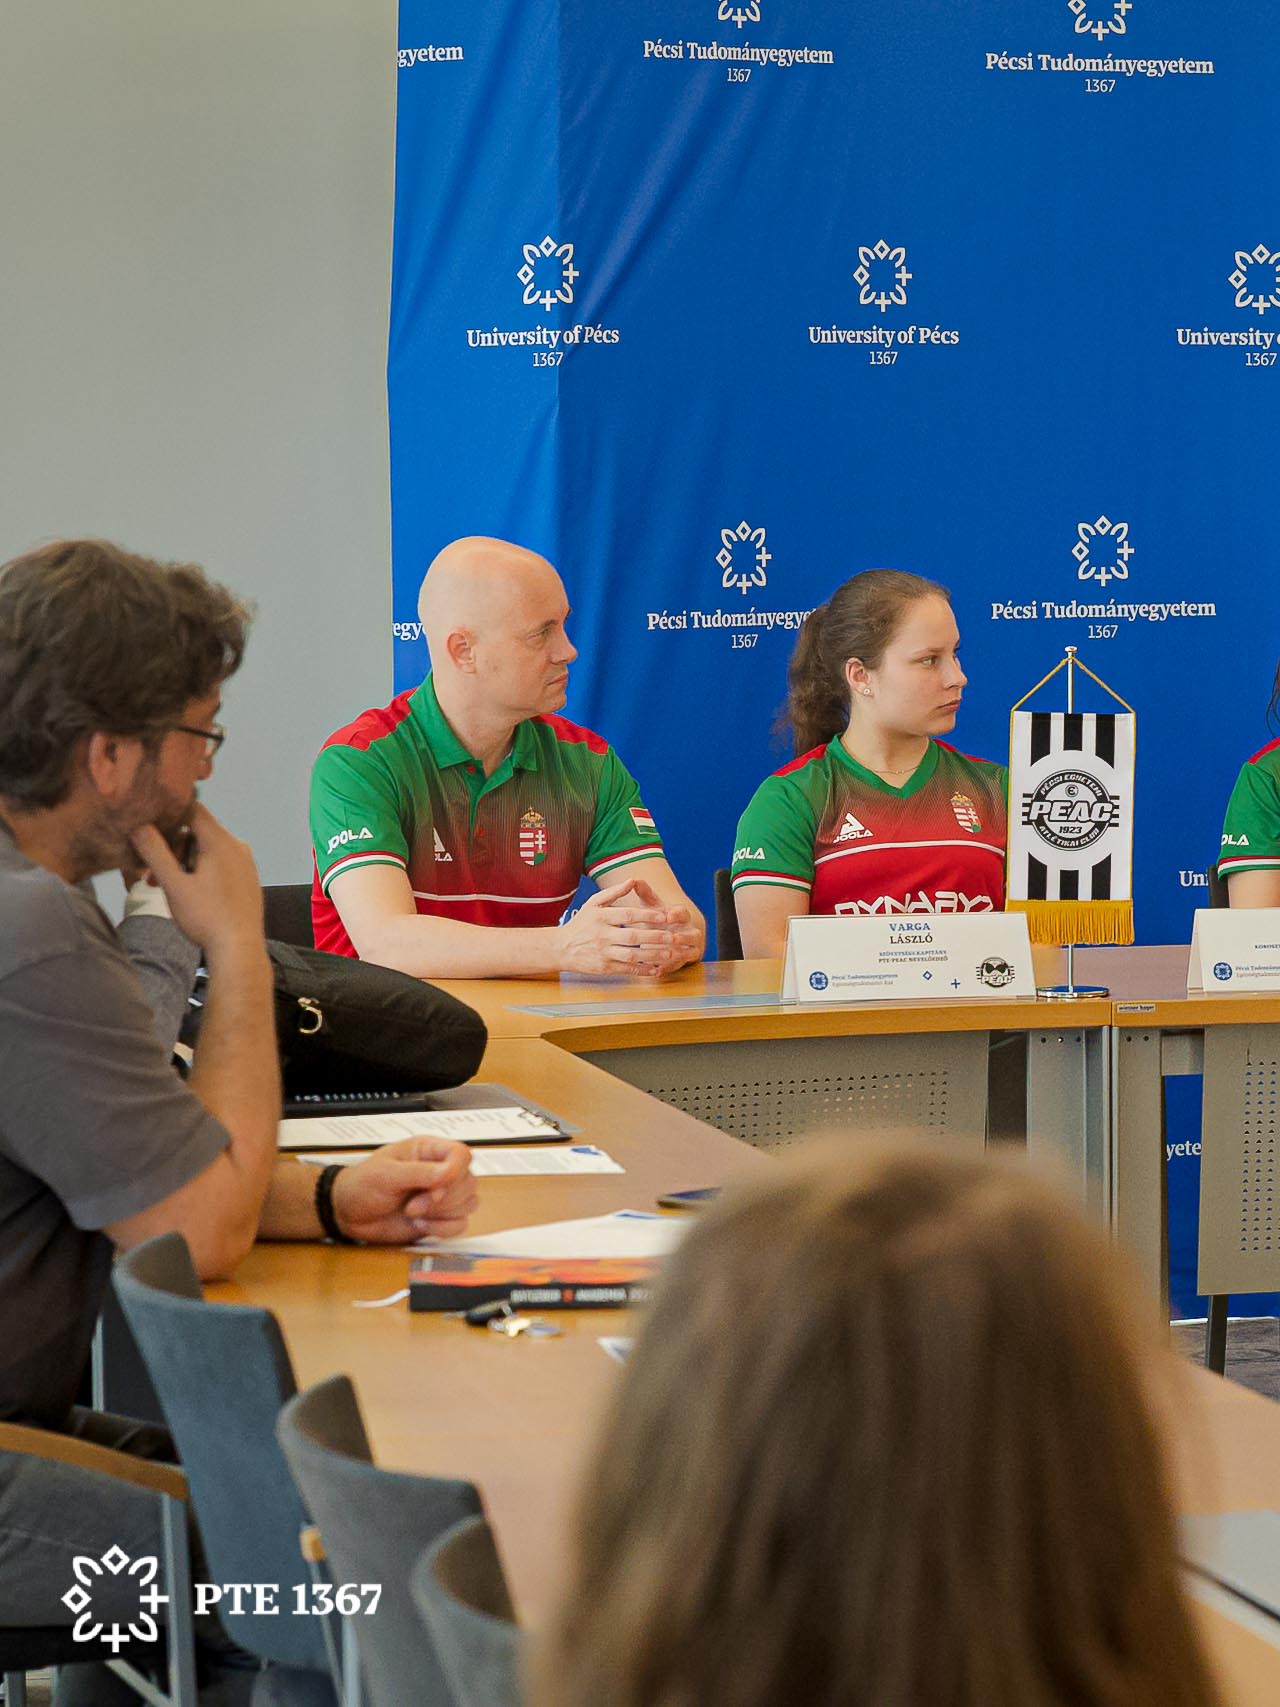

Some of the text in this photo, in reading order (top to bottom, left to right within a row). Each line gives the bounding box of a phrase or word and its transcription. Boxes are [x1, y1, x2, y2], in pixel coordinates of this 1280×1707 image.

[643, 38, 834, 66] Pécsi Tudományegyetem
[985, 50, 1215, 78] Pécsi Tudományegyetem
[727, 68, 752, 83] 1367
[1085, 78, 1116, 93] 1367
[467, 323, 620, 348] University of Pécs
[808, 324, 960, 348] University of Pécs
[1176, 326, 1274, 350] University
[532, 351, 564, 367] 1367
[869, 351, 898, 365] 1367
[1245, 352, 1278, 366] 1367
[991, 598, 1217, 622] Pécsi Tudományegyetem
[646, 610, 688, 630] Pécsi
[1088, 624, 1118, 639] 1367
[731, 633, 759, 648] 1367
[1028, 801, 1113, 822] PEAC
[832, 829, 874, 844] JOOLA
[1059, 826, 1082, 834] 1923
[889, 922, 931, 931] VARGA
[889, 934, 933, 944] LÁSZLÓ
